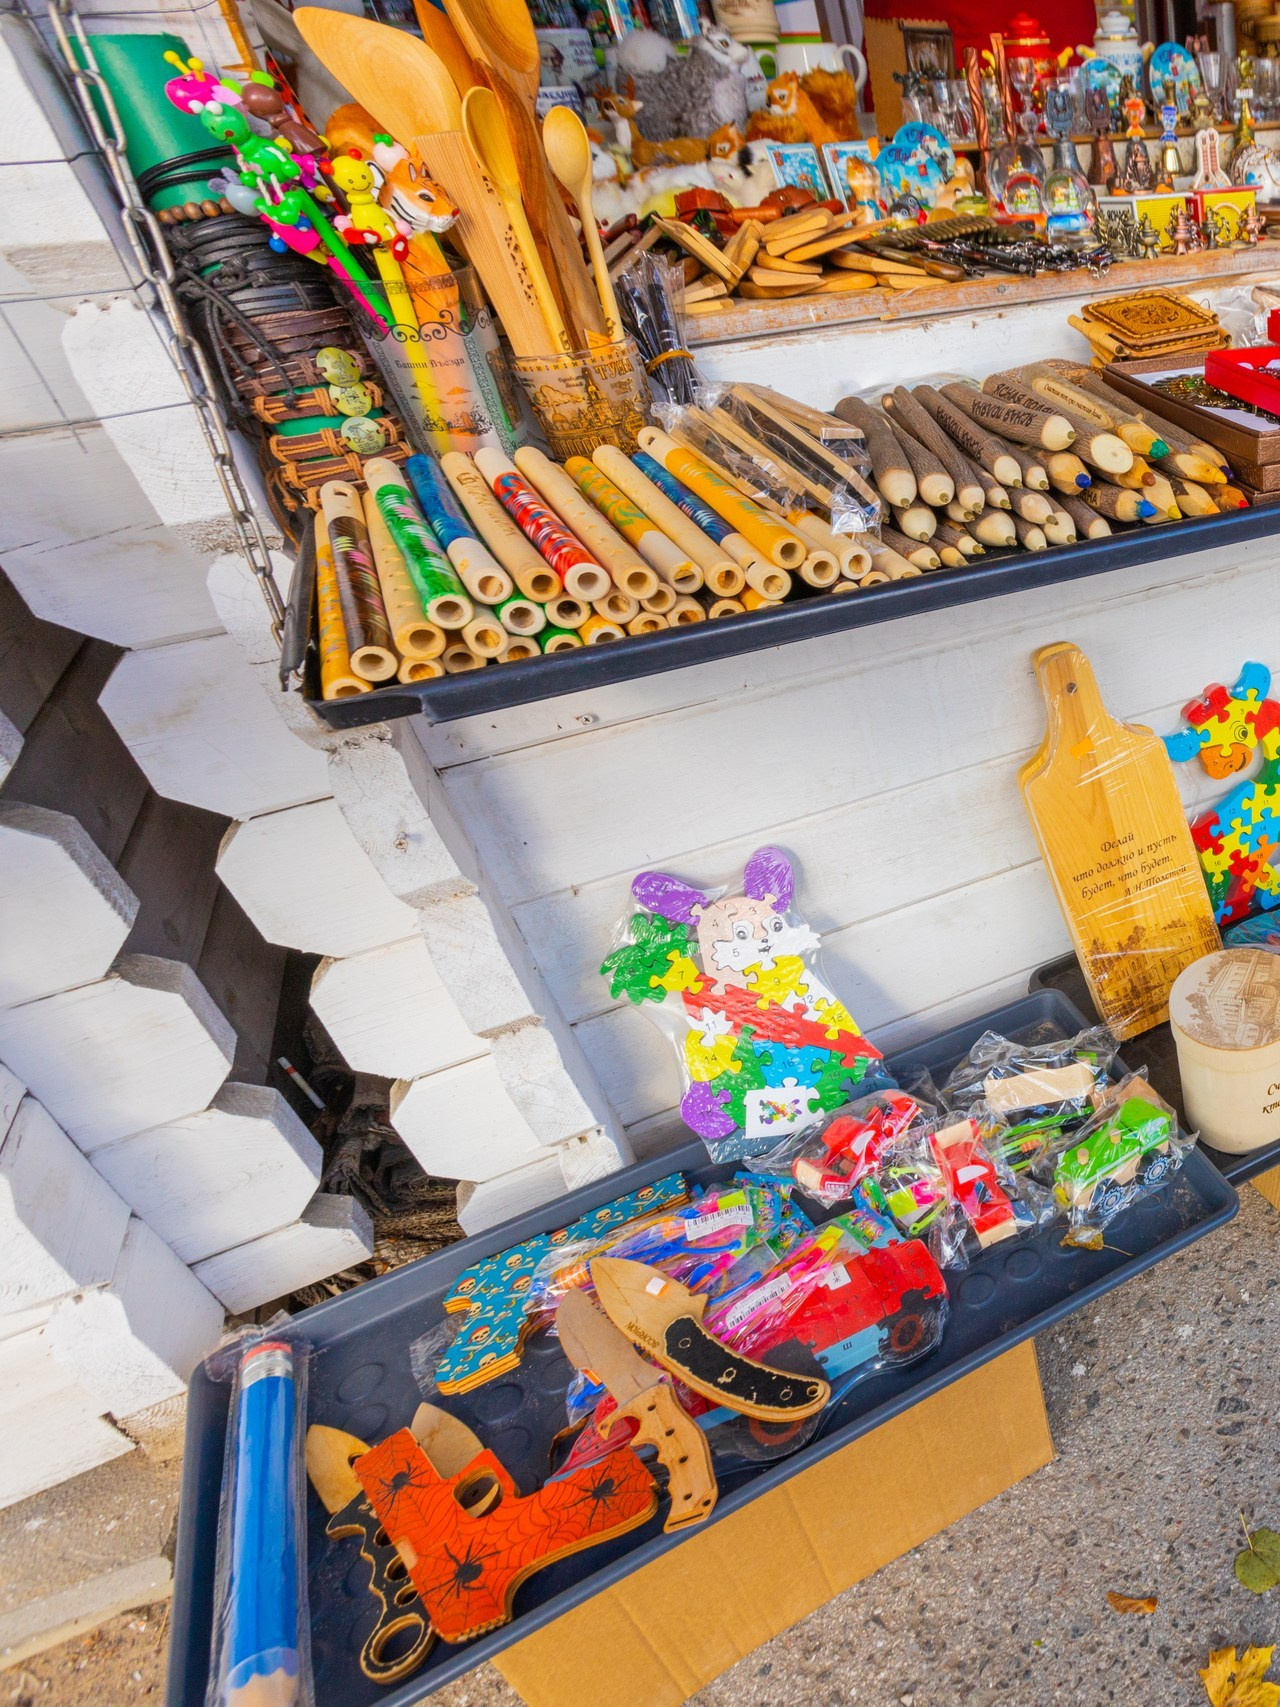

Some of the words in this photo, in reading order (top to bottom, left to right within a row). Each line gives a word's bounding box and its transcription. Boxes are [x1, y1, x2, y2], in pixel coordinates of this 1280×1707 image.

[993, 383, 1026, 405] ЯСНАЯ
[971, 399, 1005, 420] ПОЛЯНА
[1002, 408, 1038, 428] ЯСНАЯ
[1100, 832, 1135, 852] Делай
[1072, 868, 1094, 883] что
[1096, 851, 1135, 874] должно
[1137, 847, 1144, 855] и
[1146, 834, 1177, 854] пусть
[1081, 880, 1115, 900] будет,
[1117, 868, 1138, 883] что
[1140, 854, 1173, 874] будет.
[749, 906, 757, 915] 3
[711, 918, 720, 928] 4
[732, 948, 740, 957] 5
[678, 970, 685, 980] 7
[774, 977, 780, 986] 9
[801, 995, 814, 1005] 12
[704, 1020, 718, 1032] 11
[704, 1054, 717, 1063] 14
[781, 1059, 795, 1069] 16
[865, 1082, 878, 1093] 21
[833, 1276, 841, 1284] Ж
[625, 1321, 660, 1348] SCORPION
[842, 1341, 853, 1351] Ш
